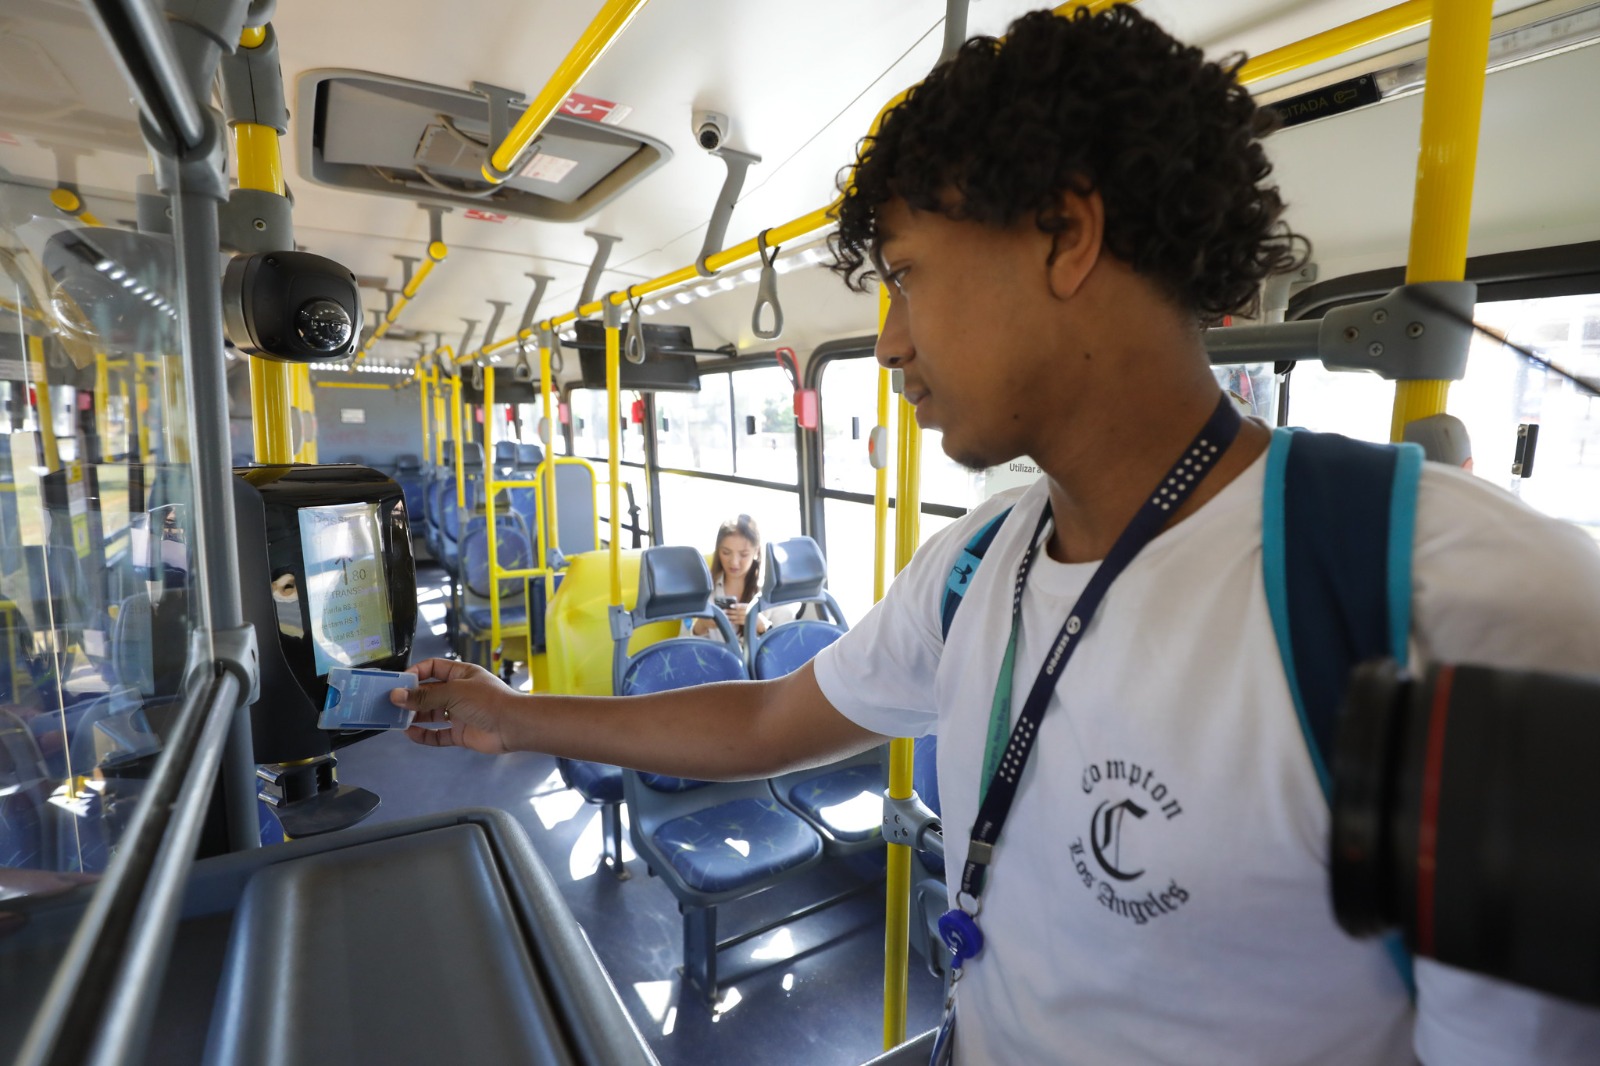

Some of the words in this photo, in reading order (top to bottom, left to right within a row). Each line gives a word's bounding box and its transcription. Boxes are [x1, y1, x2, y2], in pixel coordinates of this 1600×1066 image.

[1009, 463, 1036, 473] Utilizar
[1046, 635, 1070, 676] SERPRO
[1082, 759, 1184, 820] Compton
[1090, 798, 1148, 882] C
[1068, 836, 1097, 889] Los
[1097, 877, 1190, 925] Angeles
